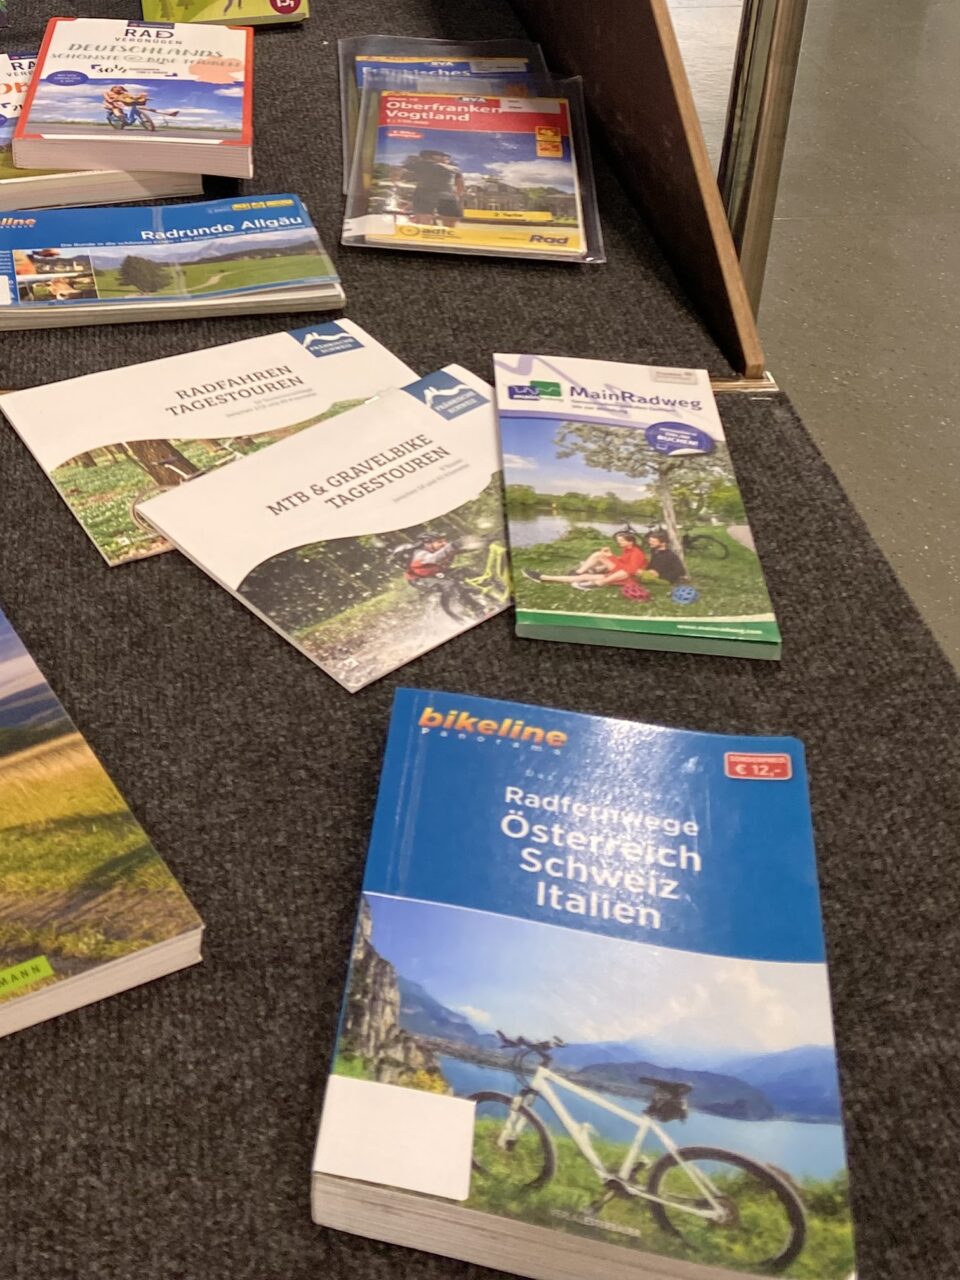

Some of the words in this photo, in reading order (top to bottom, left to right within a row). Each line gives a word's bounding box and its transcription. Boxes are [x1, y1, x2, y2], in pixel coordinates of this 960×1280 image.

[385, 110, 470, 122] Vogtland
[386, 100, 503, 114] Oberfranken
[140, 223, 235, 241] Radrunde
[241, 216, 303, 231] Allgäu
[530, 234, 570, 245] Rad
[166, 376, 304, 417] TAGESTOUREN
[176, 365, 293, 400] RADFAHREN
[570, 386, 702, 411] MainRadweg
[266, 491, 310, 516] MTB
[312, 483, 327, 496] &
[326, 434, 432, 488] GRAVELBIKE
[325, 446, 450, 509] TAGESTOUREN
[418, 707, 569, 748] bikeline
[735, 764, 747, 775] €
[504, 786, 699, 837] Radfernwege
[500, 810, 702, 872] Österreich
[520, 847, 680, 900] Schweiz
[536, 881, 662, 930] Italien
